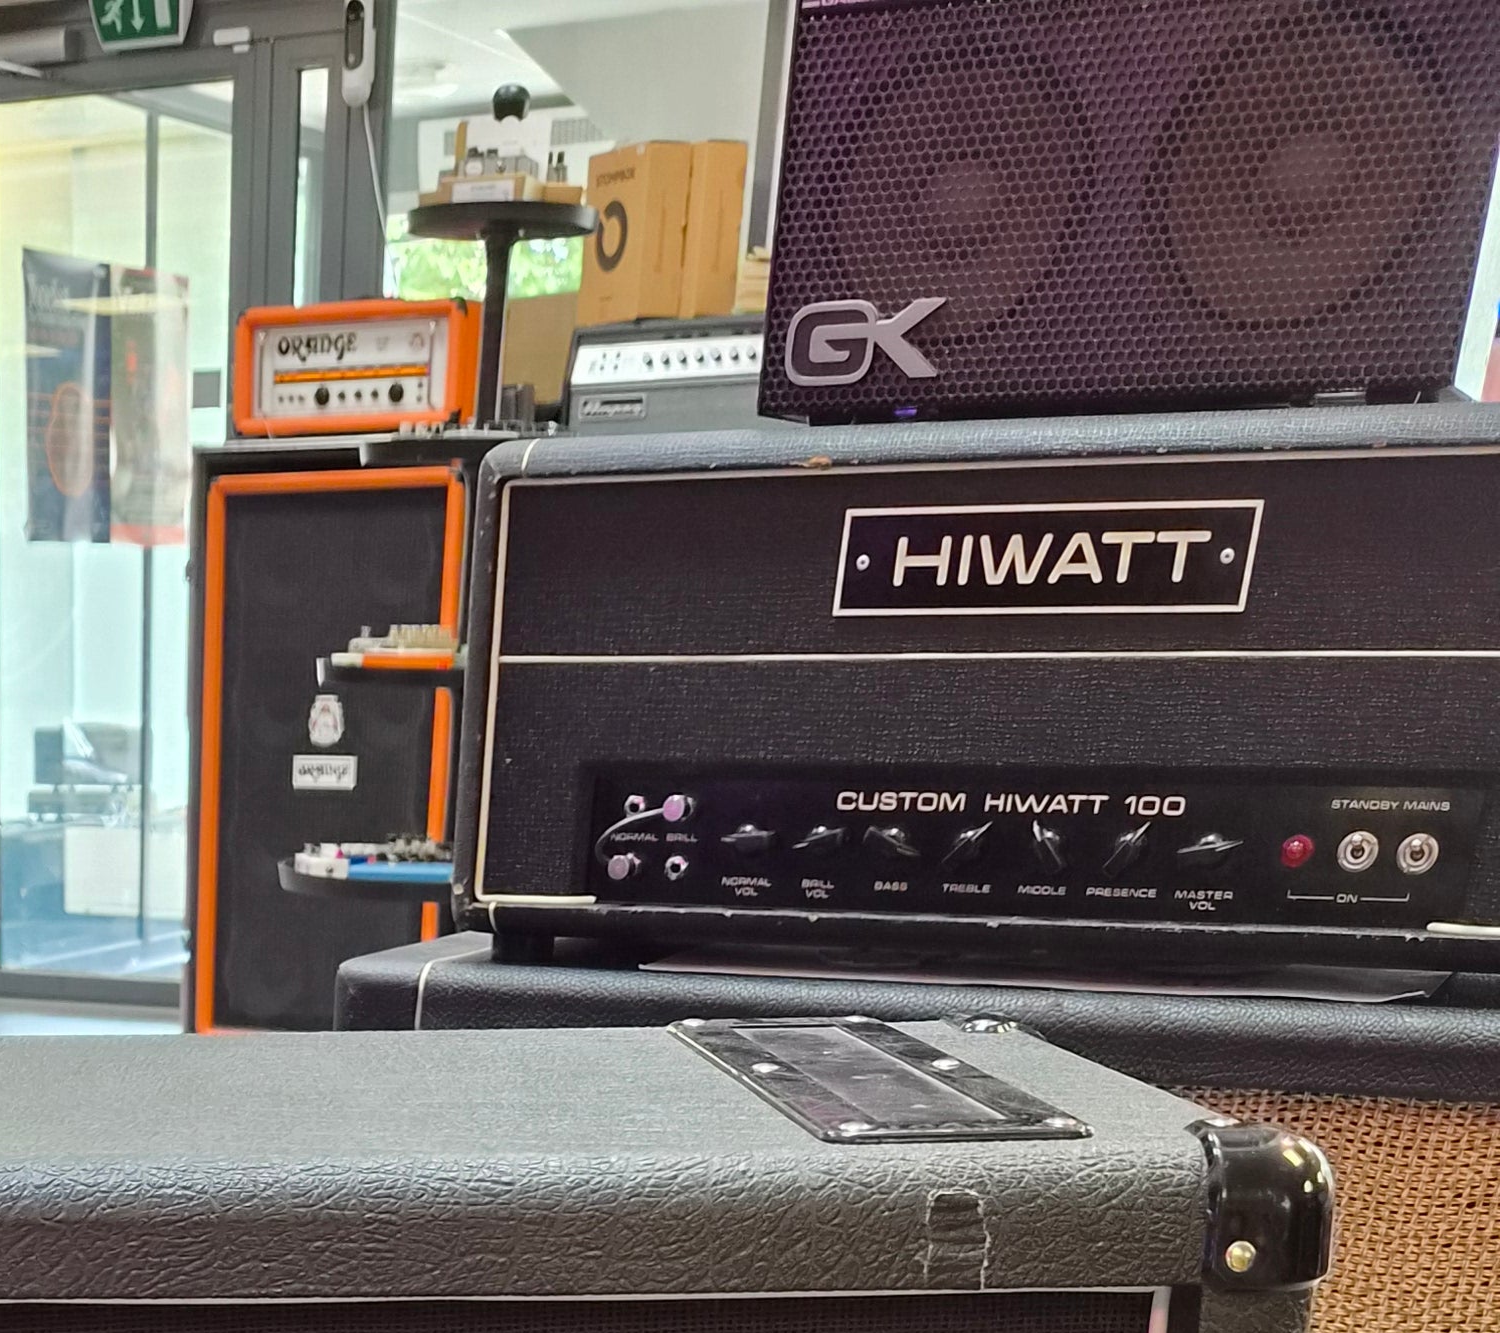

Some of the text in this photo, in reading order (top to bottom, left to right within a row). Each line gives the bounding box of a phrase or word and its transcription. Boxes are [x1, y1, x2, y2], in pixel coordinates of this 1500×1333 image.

[784, 297, 948, 388] GK
[891, 530, 1212, 588] HIWATT
[836, 791, 1187, 817] CUSTOM HIWATT 100
[1330, 798, 1451, 812] STANDBY MAINS
[610, 832, 659, 842] NORMAL
[665, 832, 698, 843] BRILL
[720, 876, 772, 888] NORMAL
[801, 878, 835, 889] BRILL
[873, 880, 908, 892] BASS
[941, 882, 992, 894] TREBLE
[734, 886, 759, 897] VOL
[805, 889, 829, 899] VOL
[1017, 884, 1067, 896] MIDDLE
[1085, 886, 1158, 898] PRESENCE
[1174, 889, 1234, 900] MASTER
[1335, 893, 1359, 904] ON
[1188, 900, 1216, 911] VOL
